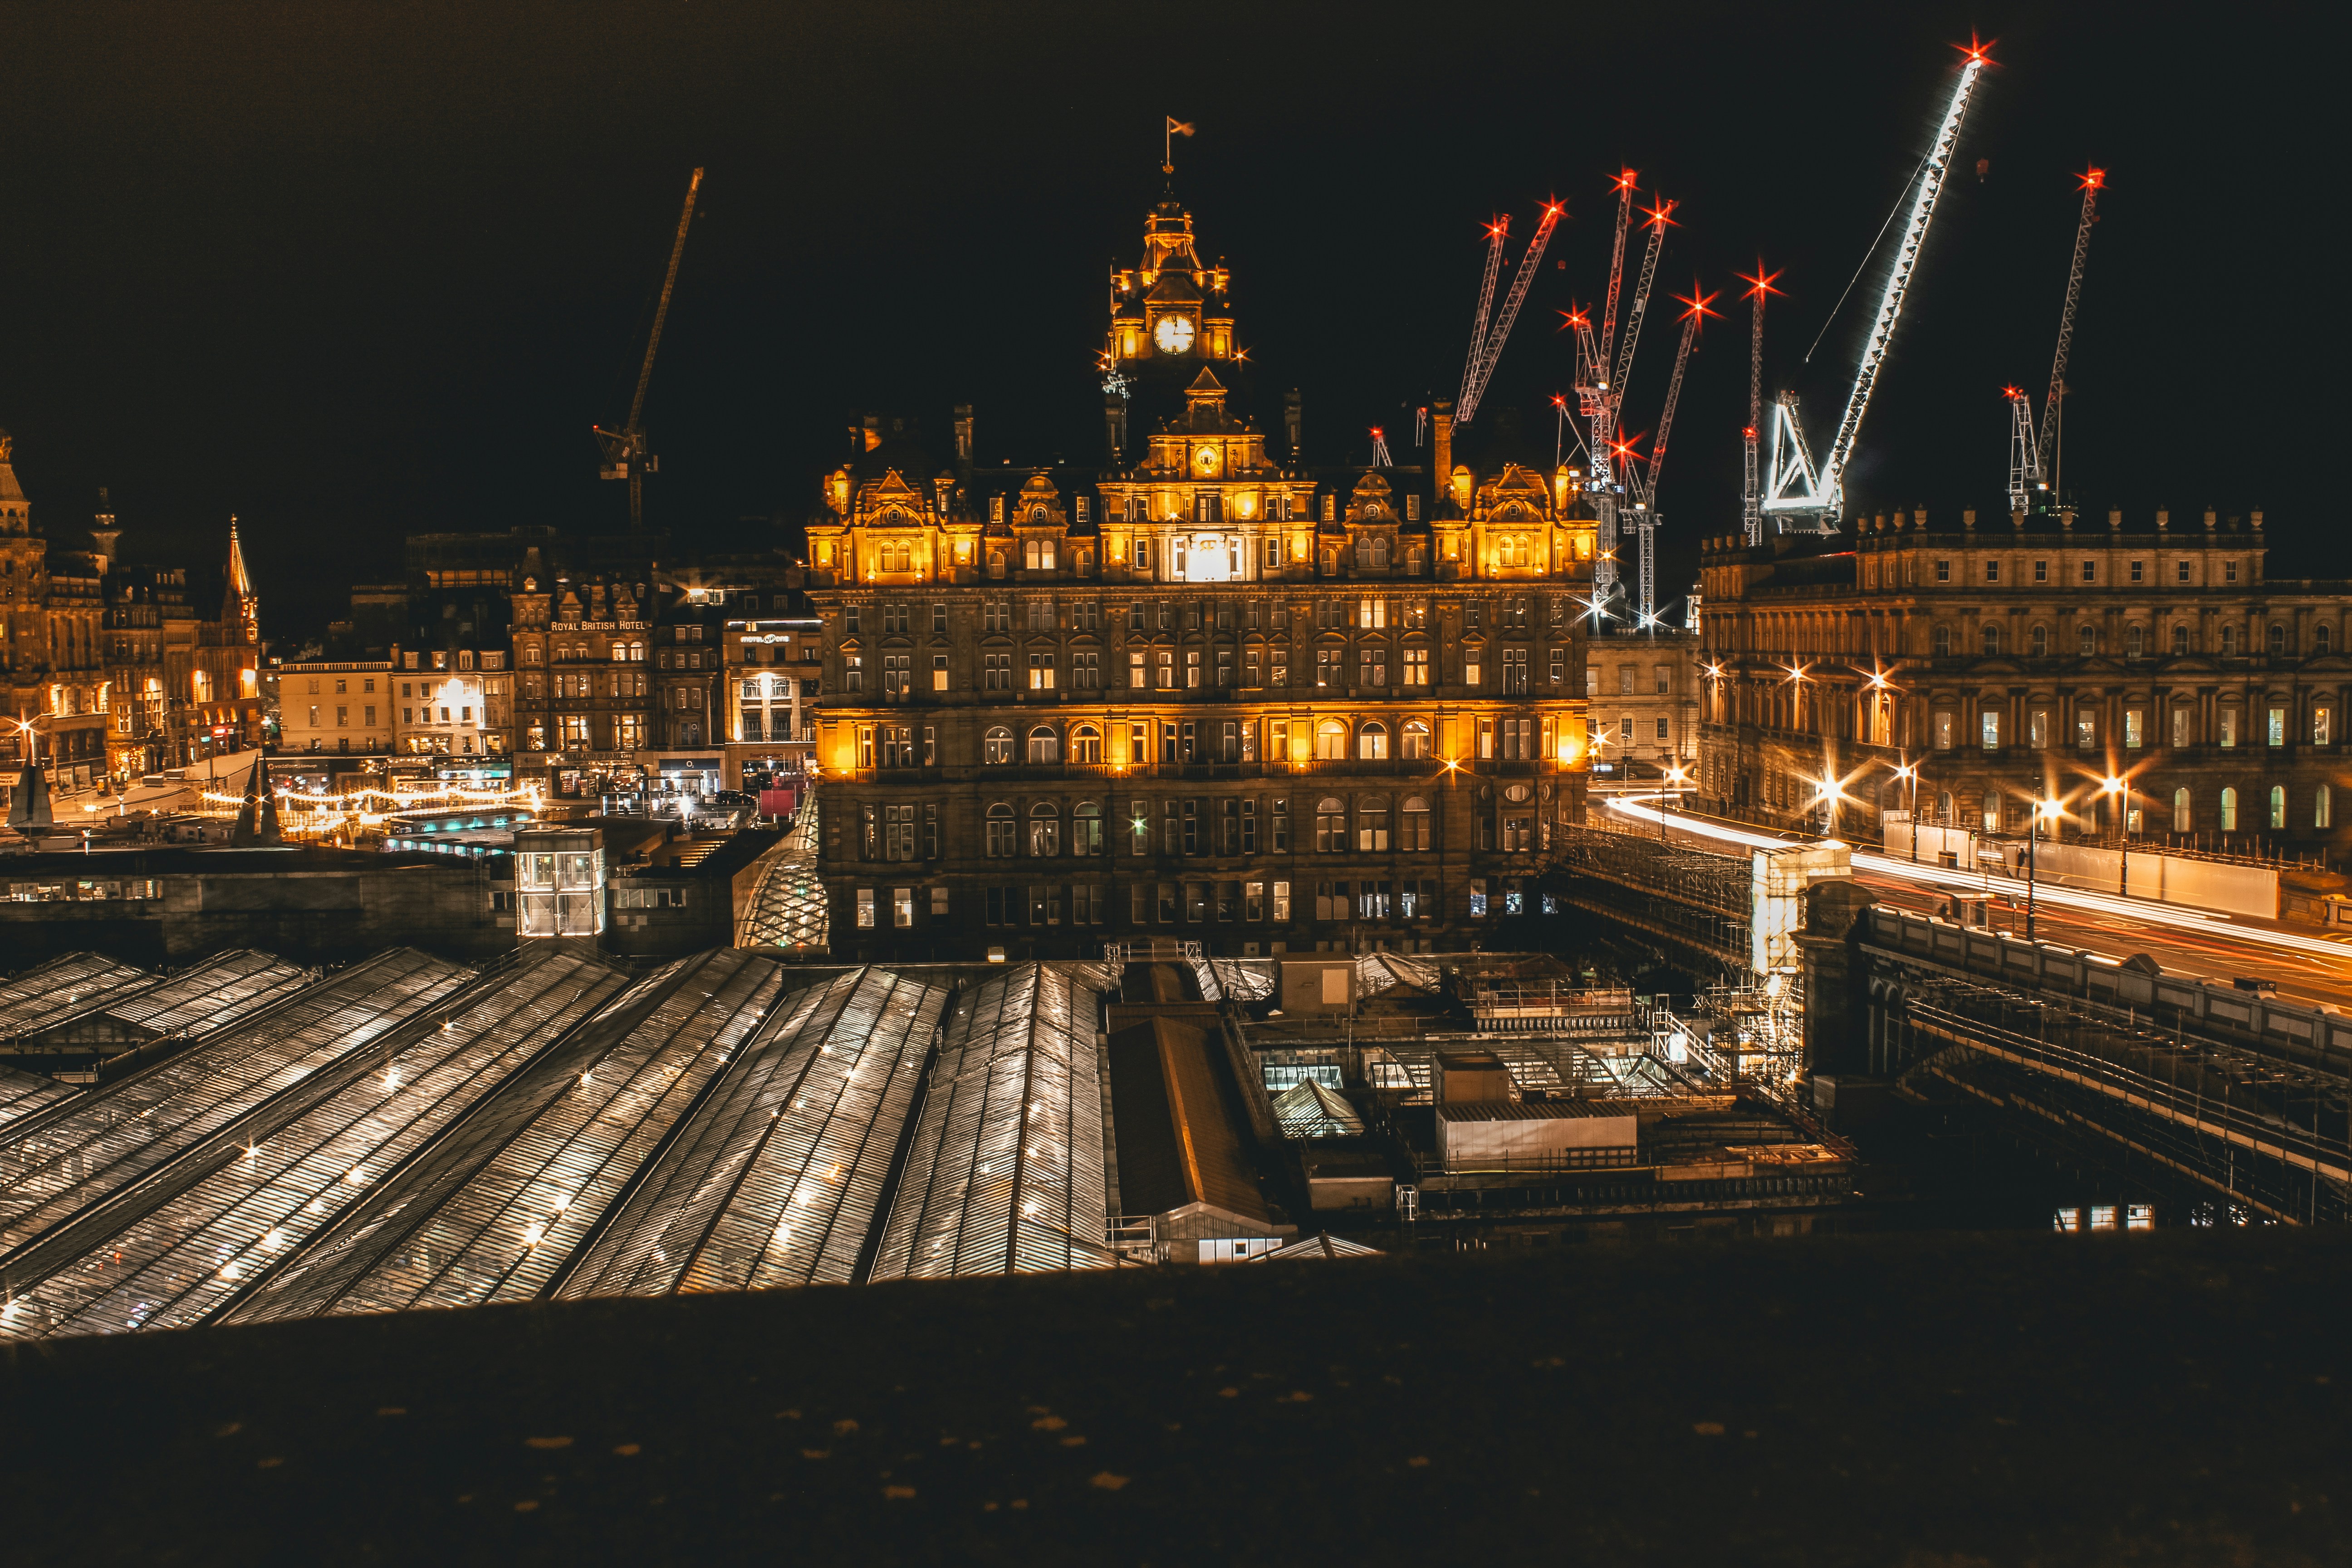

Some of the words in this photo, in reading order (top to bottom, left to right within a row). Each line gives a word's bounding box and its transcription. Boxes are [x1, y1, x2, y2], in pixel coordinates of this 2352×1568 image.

[552, 622, 578, 631] ROYAL
[582, 621, 615, 630] BRITISH
[620, 621, 645, 629] HOTEL
